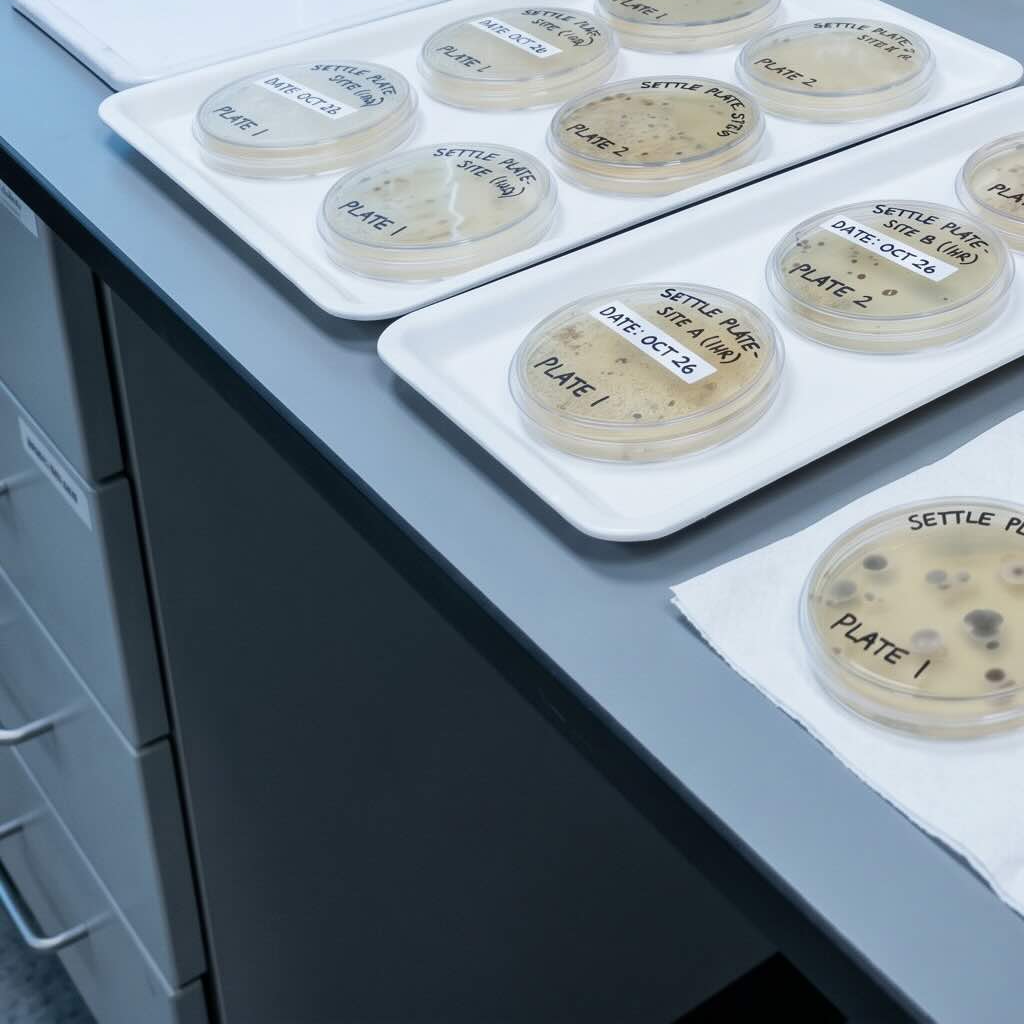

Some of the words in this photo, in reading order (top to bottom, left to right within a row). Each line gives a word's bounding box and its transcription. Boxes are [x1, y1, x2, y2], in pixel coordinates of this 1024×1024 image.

[531, 18, 560, 32] SITE
[508, 32, 535, 47] OCT
[436, 45, 482, 67] PLATE
[311, 64, 370, 77] SETTLE
[328, 75, 361, 91] SITE
[754, 58, 804, 81] PLATE
[801, 78, 819, 88] 2
[297, 93, 327, 108] OCT
[641, 81, 703, 91] SETTLE
[704, 87, 745, 111] PLATE
[213, 106, 258, 130] PLATE
[566, 123, 615, 150] PLATE
[612, 147, 629, 157] 2
[433, 148, 500, 161] SETTLE
[457, 160, 493, 178] SITE
[338, 200, 394, 230] PLATE
[390, 225, 408, 237] 1
[872, 204, 940, 225] SETTLE
[883, 219, 920, 238] SITE
[919, 235, 937, 245] B
[831, 220, 877, 246] DATE:
[879, 243, 919, 262] OCT
[912, 258, 937, 275] 26
[788, 263, 855, 298] PLATE
[853, 295, 874, 309] 2
[660, 288, 723, 318] SETTLE
[656, 306, 693, 328] SITE
[686, 327, 706, 339] A
[599, 306, 644, 335] DATE:
[640, 335, 678, 356] OCT
[671, 355, 698, 375] 26
[534, 356, 597, 398] PLATE
[590, 395, 610, 407] 1
[908, 510, 996, 531] SETTLE
[830, 612, 911, 666] PLATE
[914, 659, 931, 680] 1
